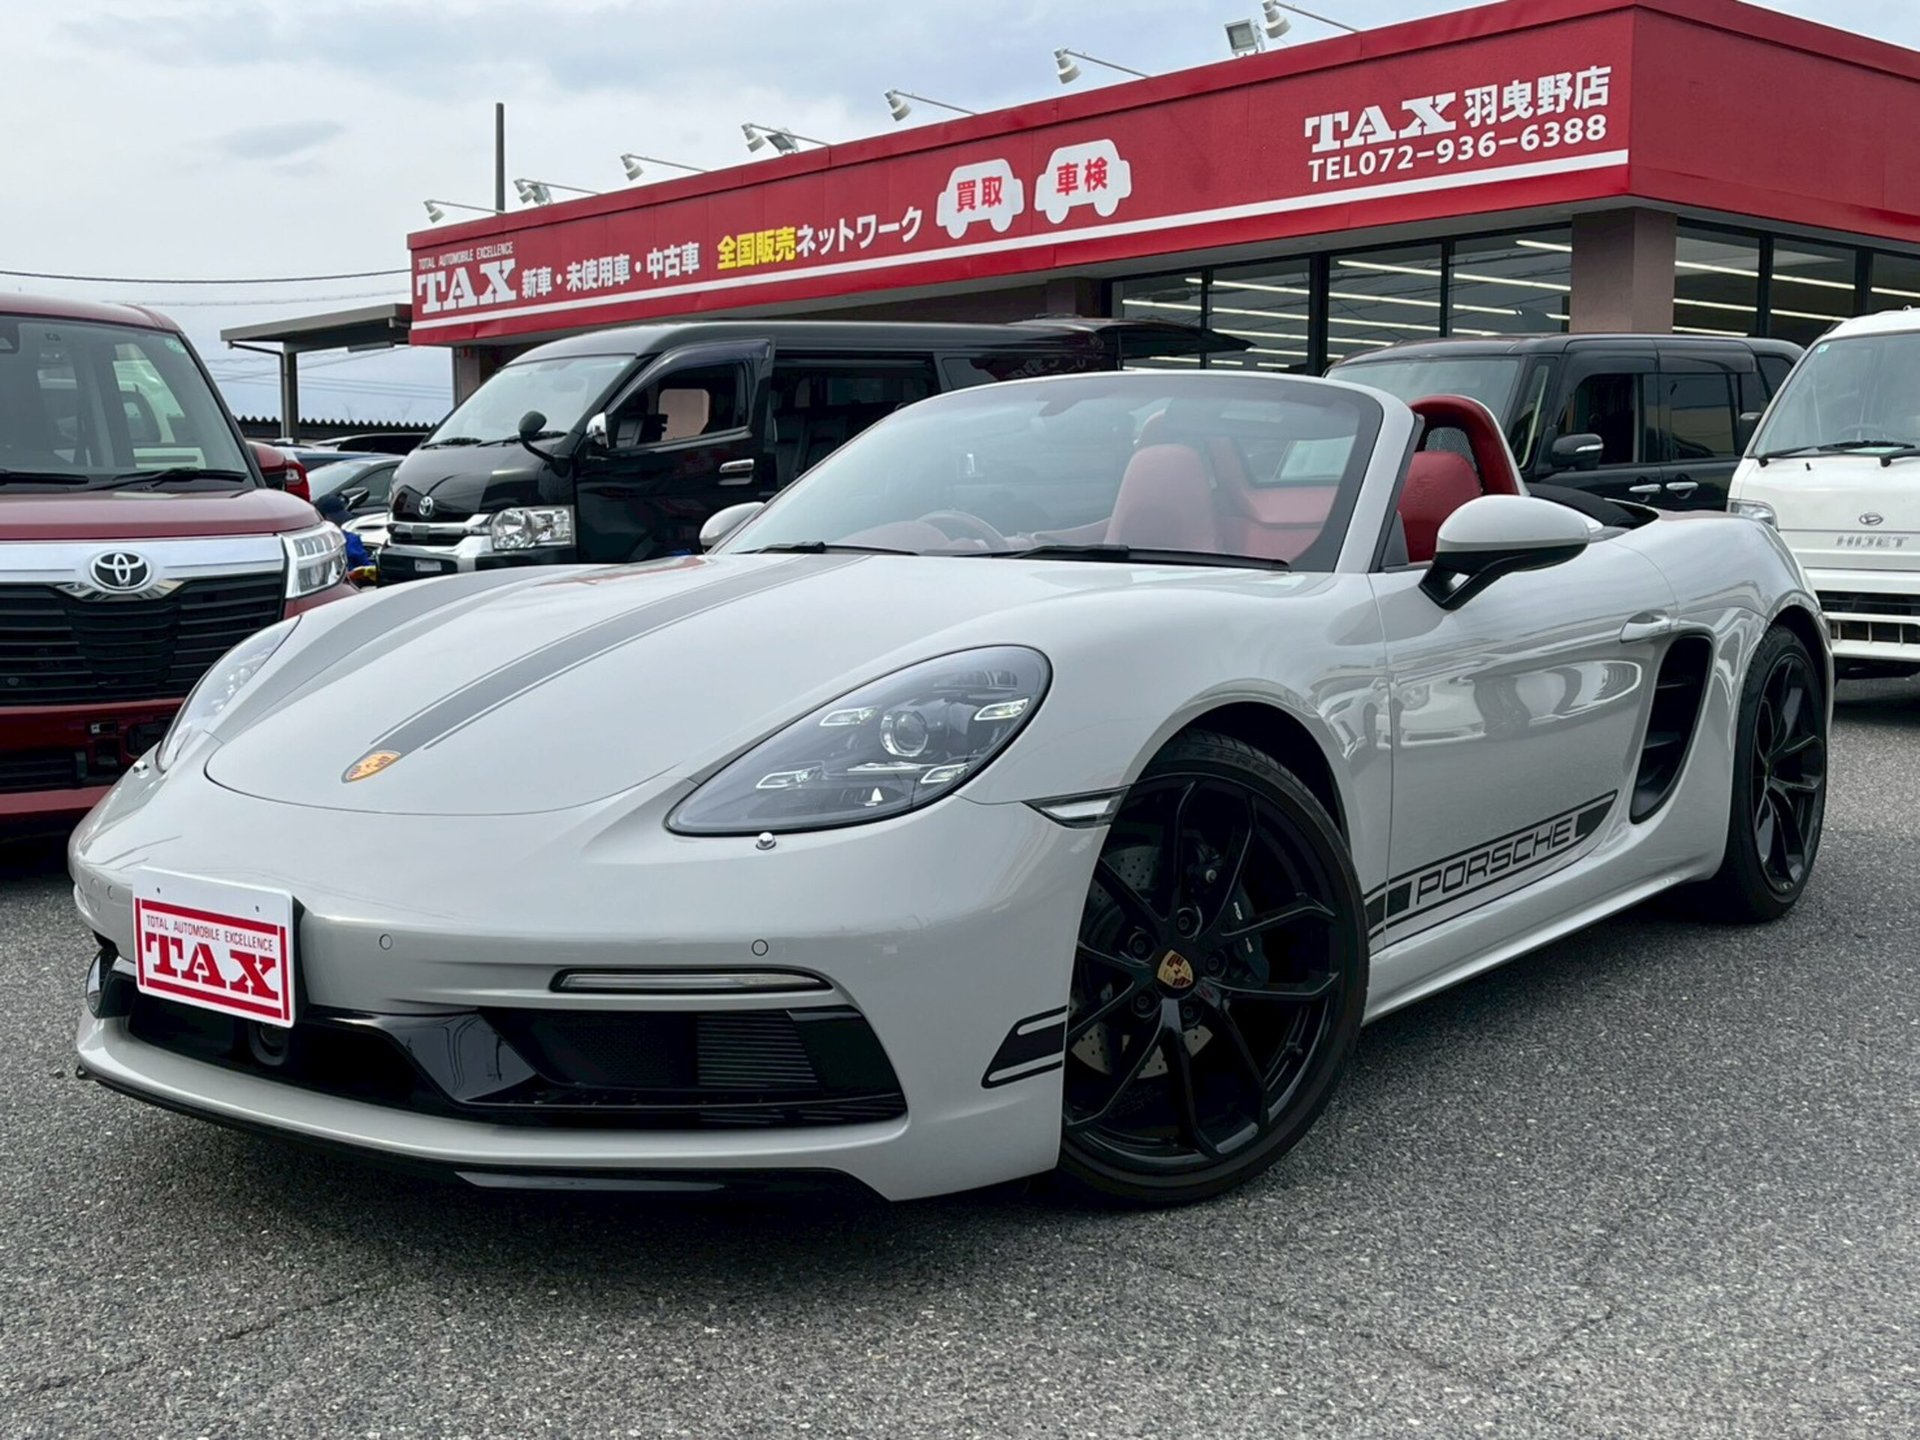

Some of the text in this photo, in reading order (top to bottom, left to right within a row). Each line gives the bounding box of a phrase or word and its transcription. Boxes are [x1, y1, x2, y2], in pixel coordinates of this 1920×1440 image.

[1305, 65, 1612, 153] TAX 羽曳野店
[1056, 156, 1109, 196] 車検
[1308, 114, 1607, 183] TEL072-936-6388
[956, 176, 1003, 213] 買取
[418, 257, 436, 271] TOTAL
[476, 241, 514, 260] EXCELLENCE
[716, 206, 923, 270] 全国販売ネットワーク
[416, 258, 517, 314] TAX
[1836, 535, 1910, 549] HIJET
[1416, 817, 1573, 905] PORSCHE
[146, 914, 273, 952] TOTAL AUTOMOBILE EXCELLENCE
[145, 931, 279, 1001] TAX
